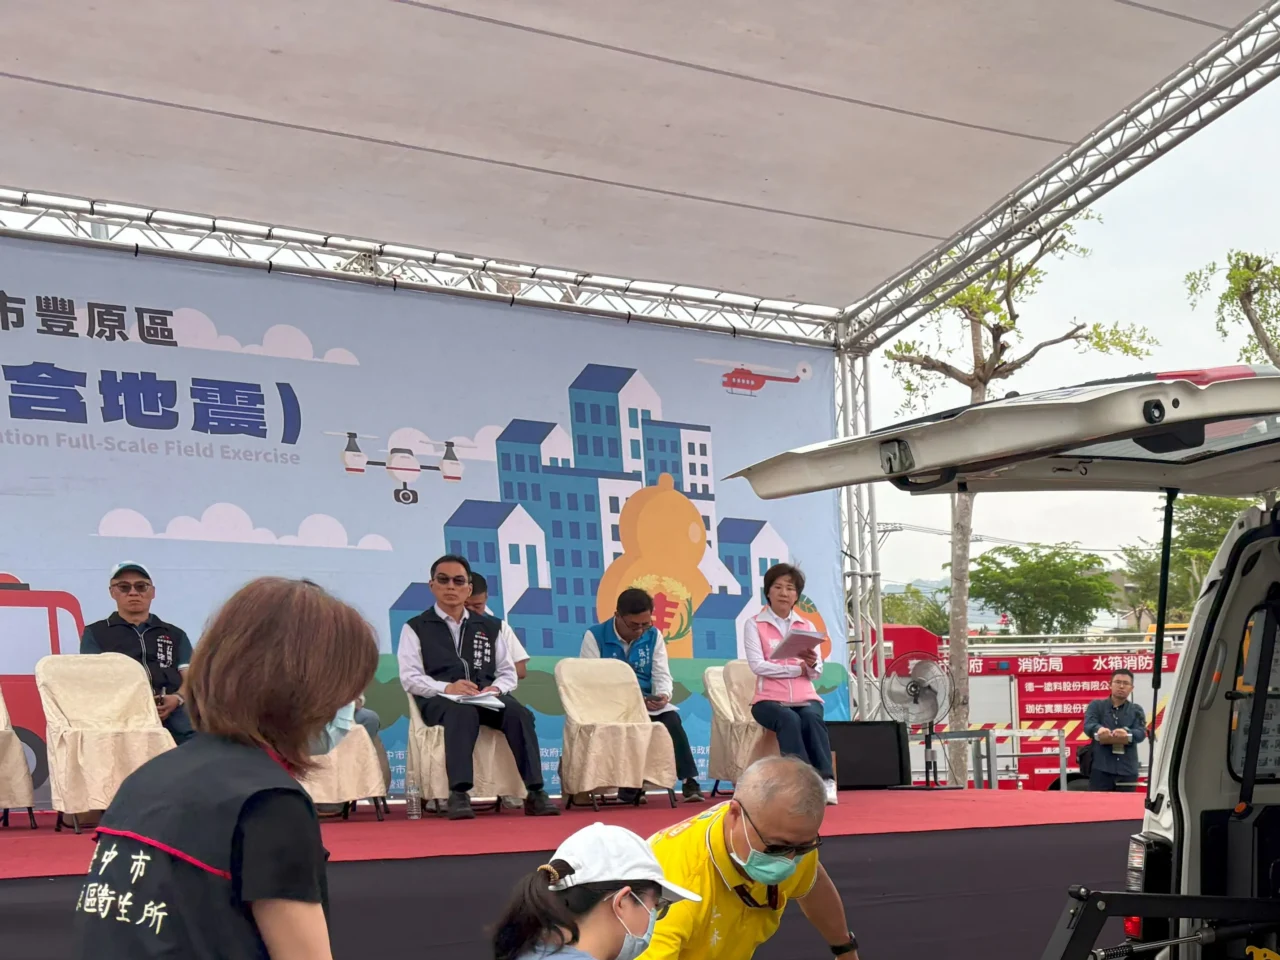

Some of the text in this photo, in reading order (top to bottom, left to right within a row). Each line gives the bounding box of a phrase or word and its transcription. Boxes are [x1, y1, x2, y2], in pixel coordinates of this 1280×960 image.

[0, 290, 178, 347] 市豐原區
[55, 432, 159, 455] Full-Scale
[165, 440, 214, 459] Field
[220, 445, 301, 466] Exercise
[1018, 657, 1063, 673] 消防局
[1025, 681, 1111, 693] 德一塗料股份有限公
[88, 840, 152, 884] 中市
[76, 883, 168, 935] 區衛生所
